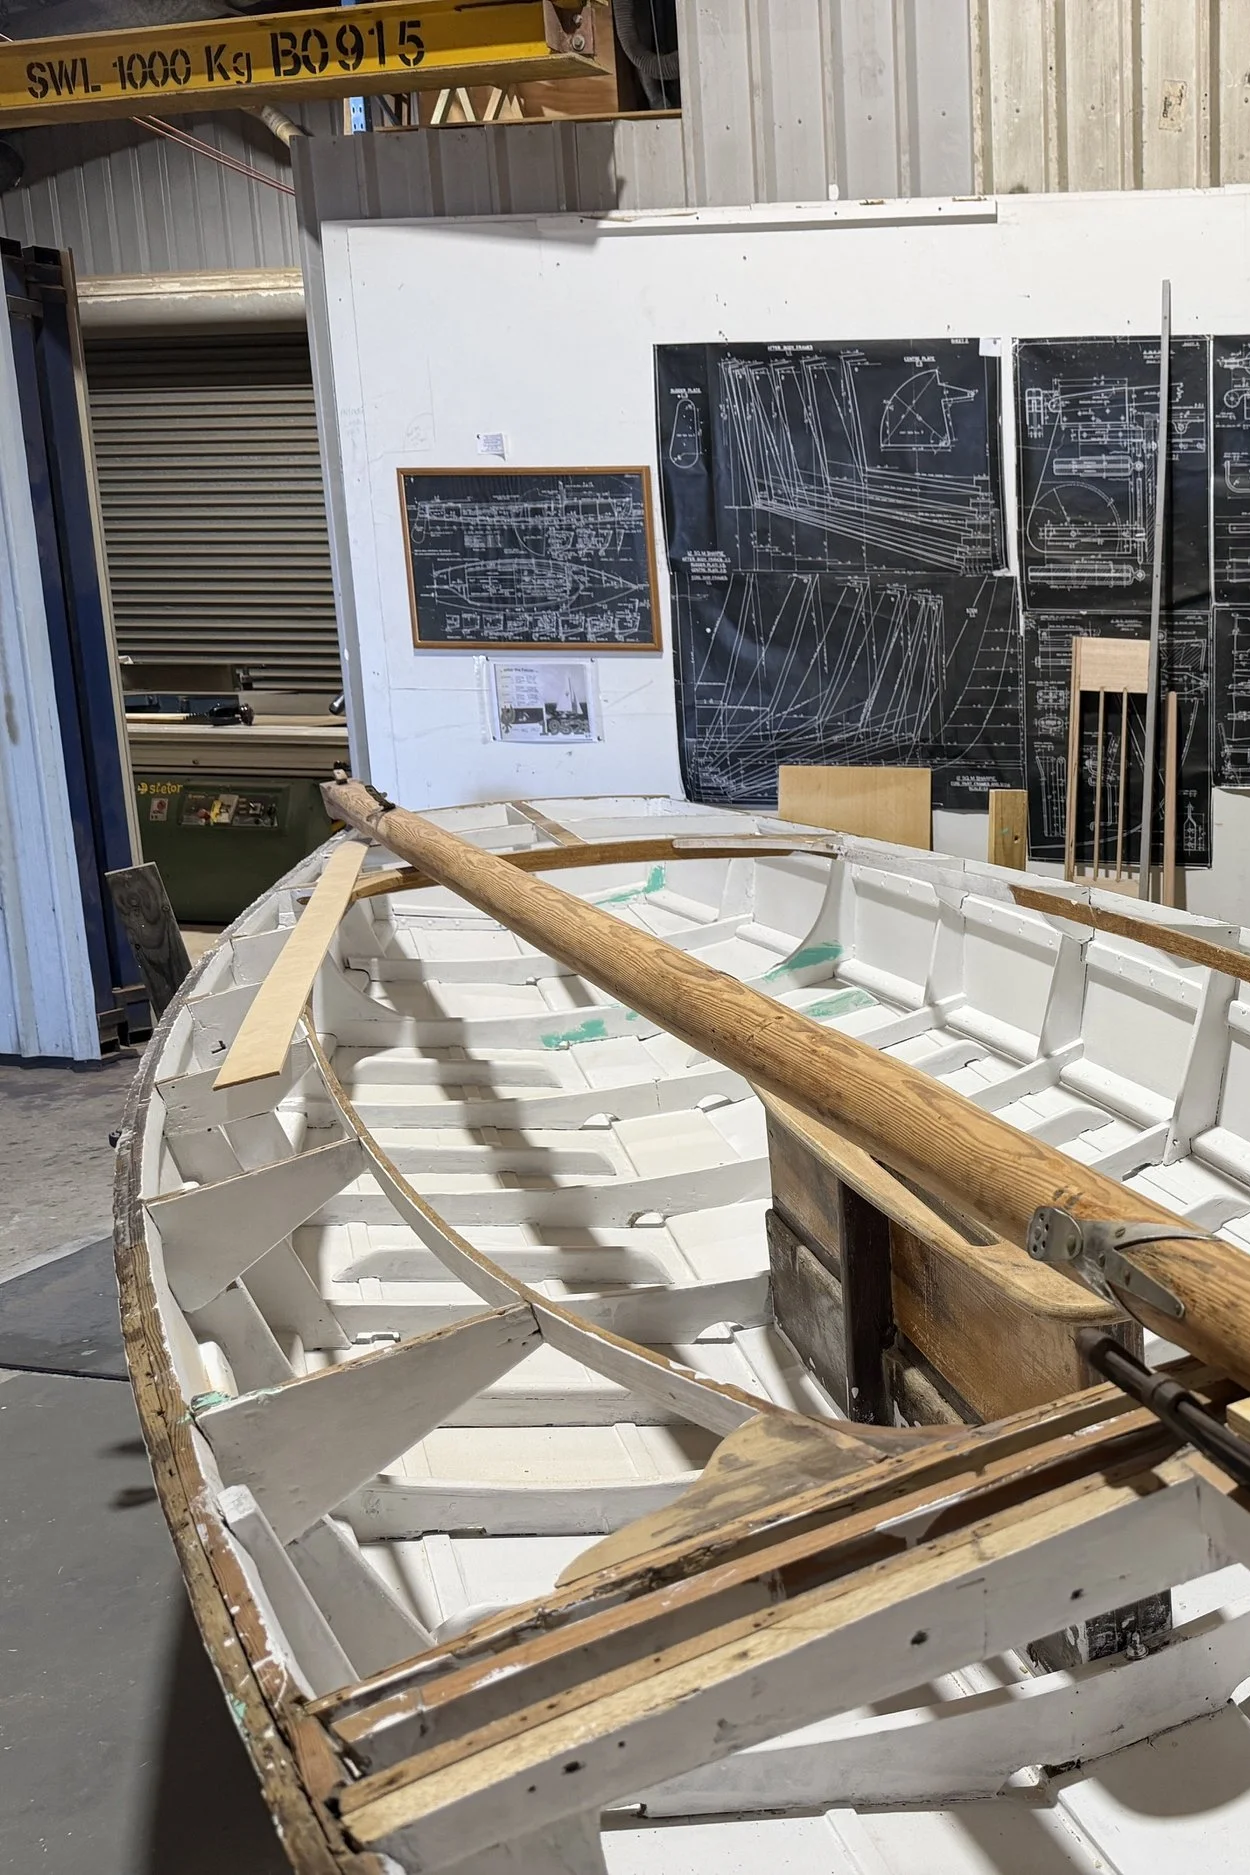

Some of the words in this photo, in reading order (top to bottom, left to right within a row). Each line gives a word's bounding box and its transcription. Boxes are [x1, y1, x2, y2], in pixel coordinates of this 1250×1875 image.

[26, 57, 101, 99] SWL
[112, 48, 192, 90] 1000
[204, 43, 252, 85] Kg
[270, 19, 425, 77] B0915
